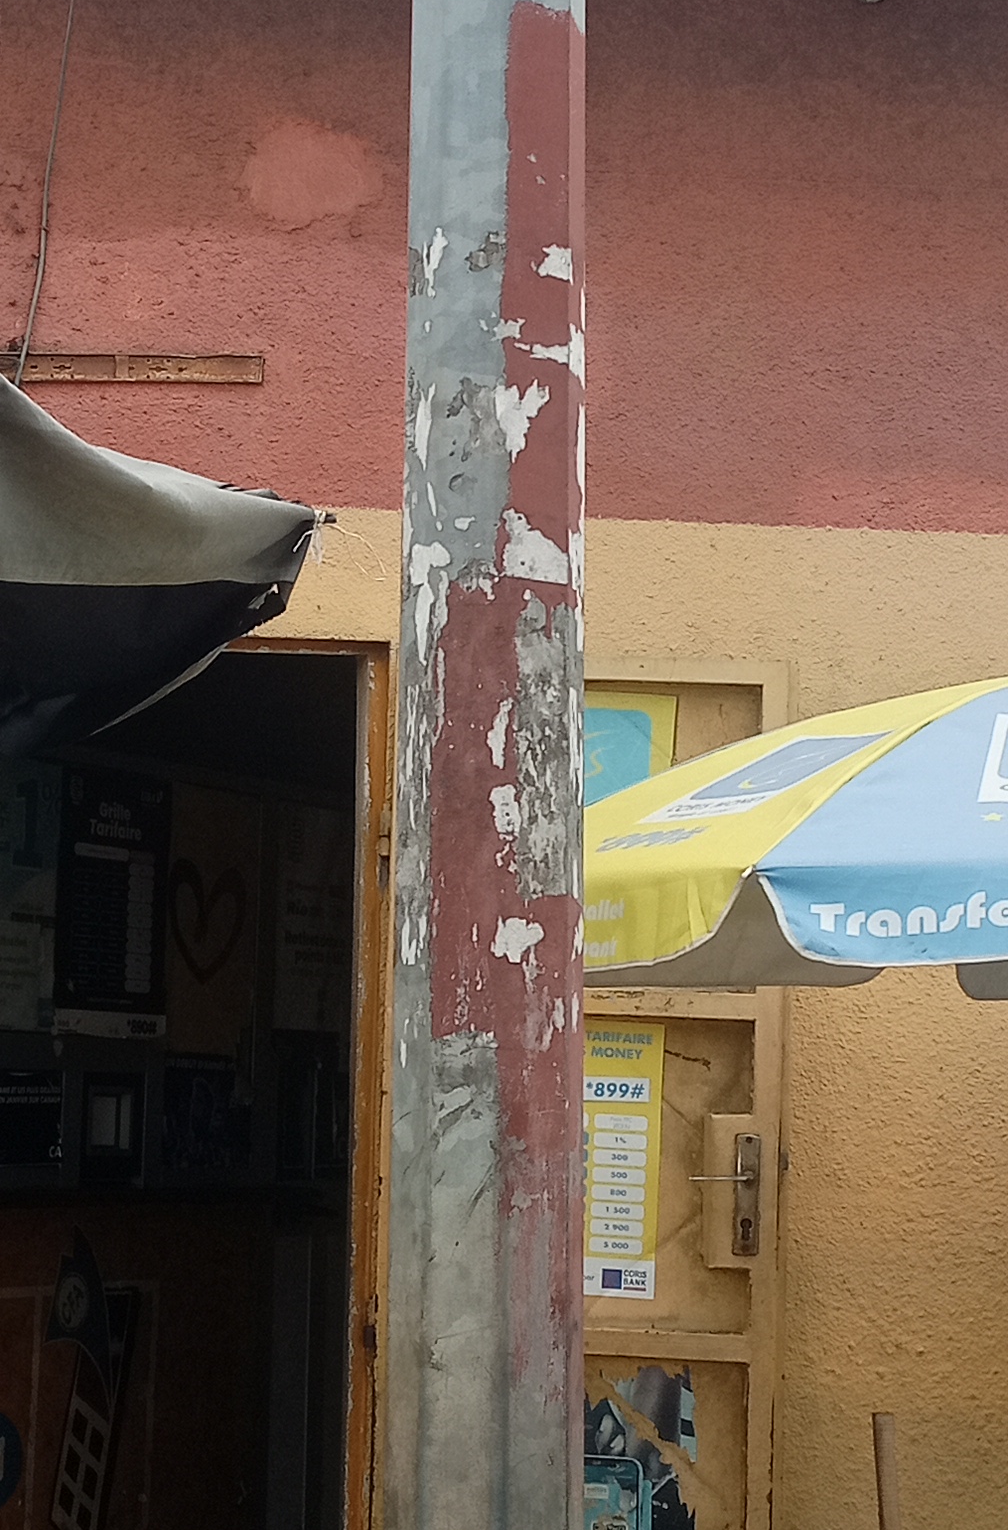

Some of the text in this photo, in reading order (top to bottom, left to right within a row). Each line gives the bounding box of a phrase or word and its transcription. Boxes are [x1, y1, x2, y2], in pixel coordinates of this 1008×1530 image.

[99, 801, 132, 820] Grille
[89, 818, 142, 841] Tarifaire
[585, 1030, 654, 1046] TARIFAIRE
[591, 1045, 643, 1060] MONEY
[611, 1171, 628, 1179] 500
[623, 1269, 647, 1278] CORIS
[623, 1278, 647, 1287] BANK
